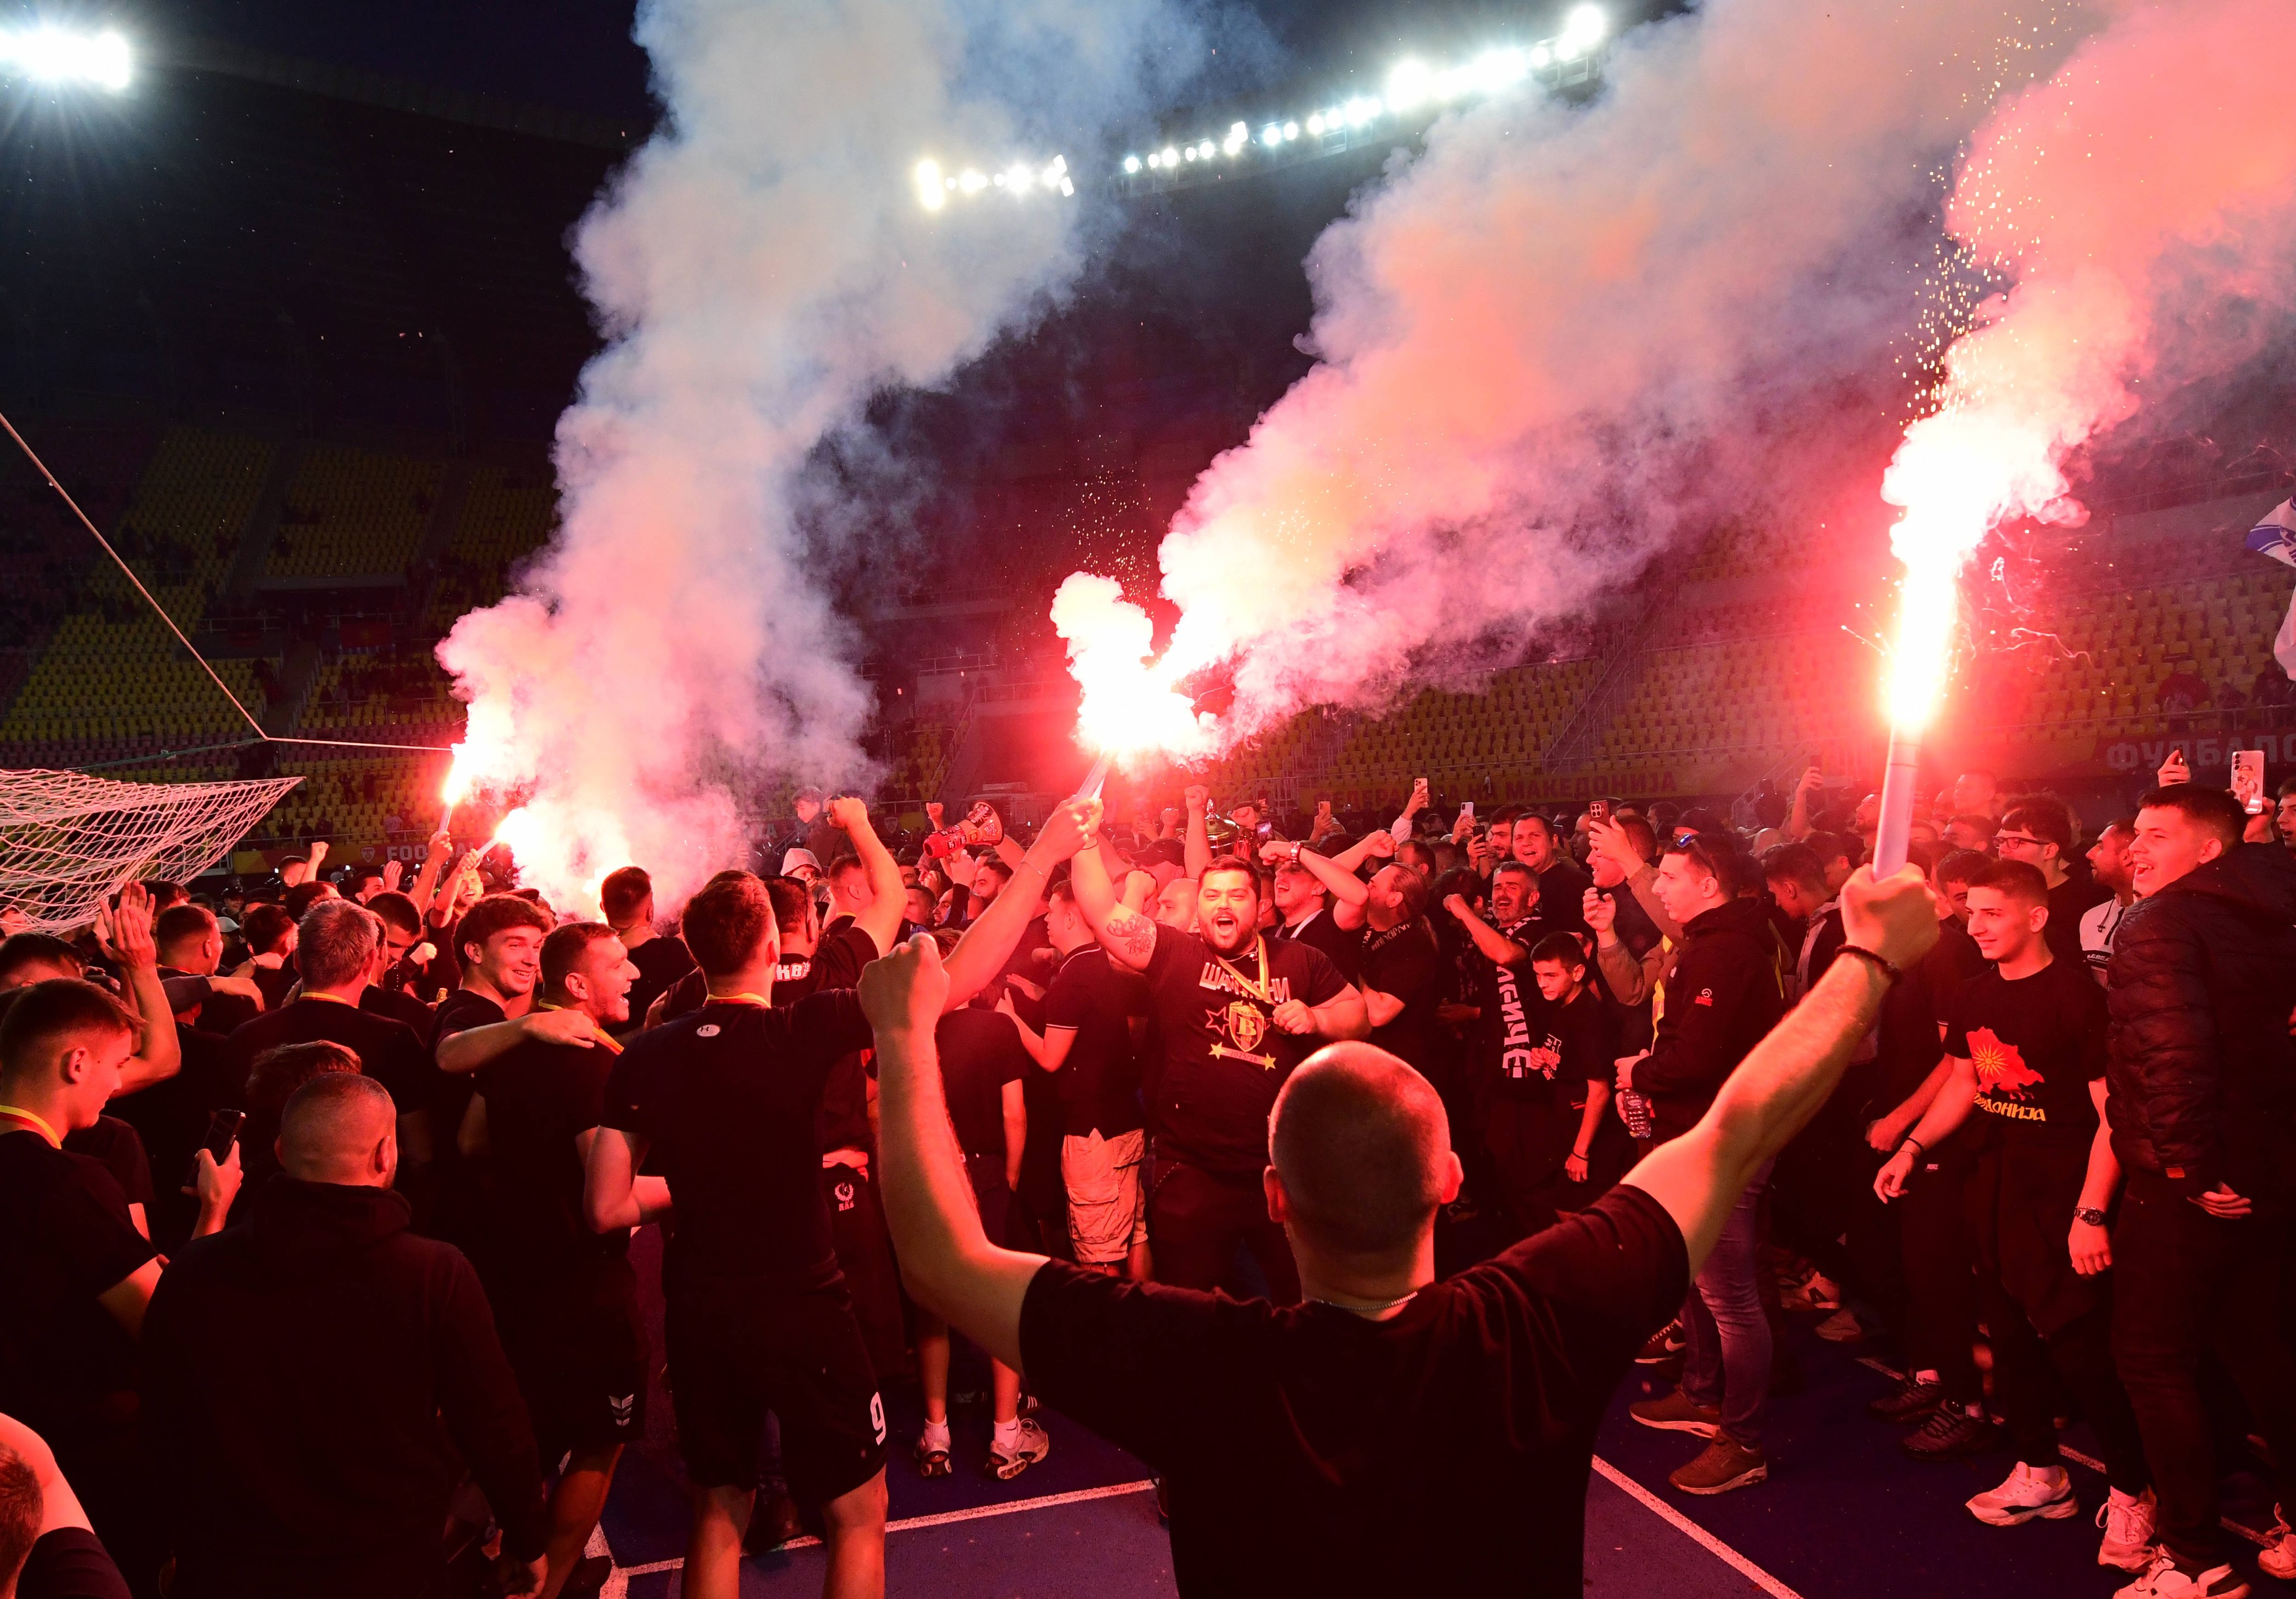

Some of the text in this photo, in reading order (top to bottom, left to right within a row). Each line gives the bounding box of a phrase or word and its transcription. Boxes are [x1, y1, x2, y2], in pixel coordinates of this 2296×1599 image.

[1505, 771, 1677, 800] МАКЕДОНИЈА
[386, 841, 478, 861] FOOA
[1199, 962, 1291, 1003] ШАМНИ
[1230, 1050, 1257, 1062] 2025/26
[1973, 1092, 2047, 1122] ДОНИЈА
[870, 1391, 886, 1446] 9
